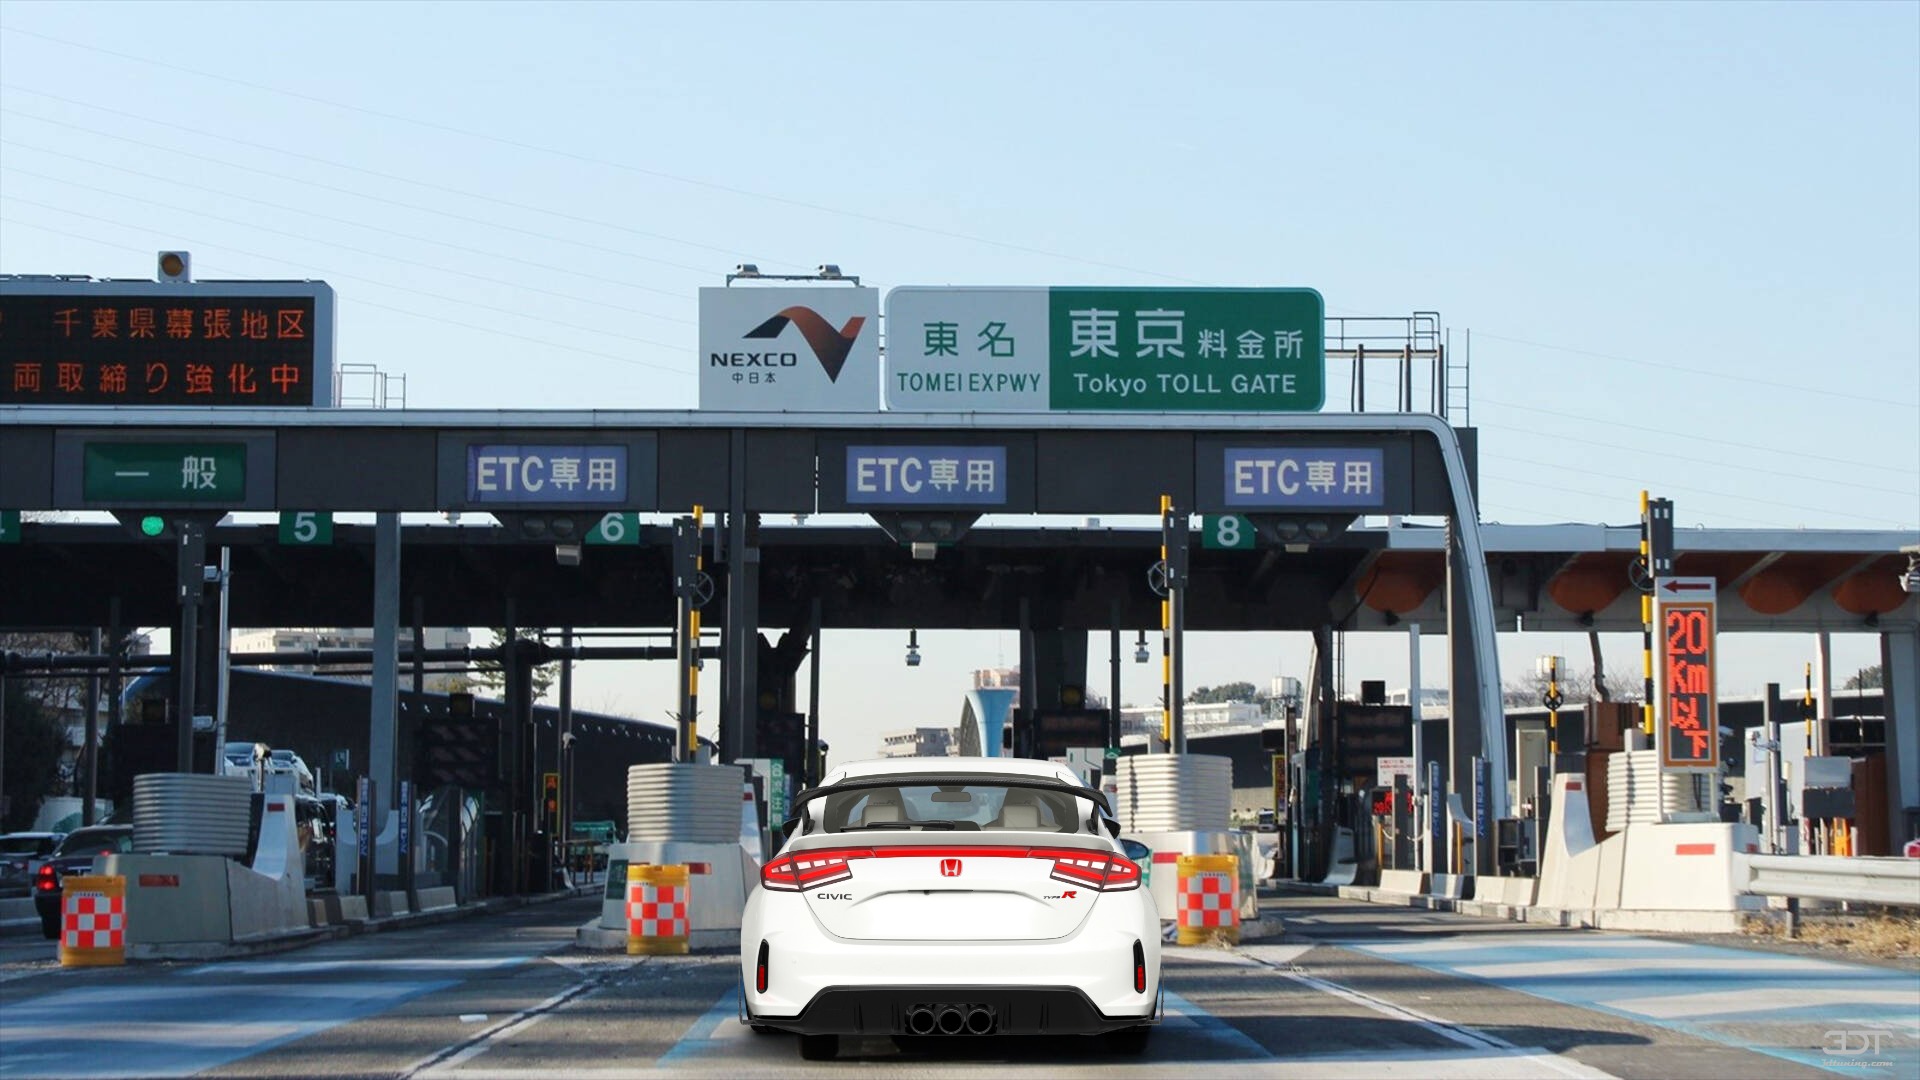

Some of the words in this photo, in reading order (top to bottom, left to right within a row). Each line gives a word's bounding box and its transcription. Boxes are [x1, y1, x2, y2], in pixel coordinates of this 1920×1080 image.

[53, 308, 305, 339] 千葉県幕張地区
[923, 321, 1015, 358] 東名
[710, 352, 797, 367] NEXCO
[13, 363, 300, 394] 両取締り強化中
[731, 371, 777, 385] 中日本
[897, 373, 963, 392] TOMEI
[969, 373, 1041, 393] EXPWY
[1073, 373, 1147, 397] Tokyo
[1156, 374, 1221, 393] TOLL
[1231, 374, 1296, 394] GATE
[114, 455, 217, 490] 一般
[293, 511, 318, 542] 5
[600, 512, 625, 542] 6
[1217, 515, 1241, 547] 8
[1666, 611, 1709, 655] 20
[1669, 696, 1710, 759] 以下
[1061, 890, 1077, 899] R
